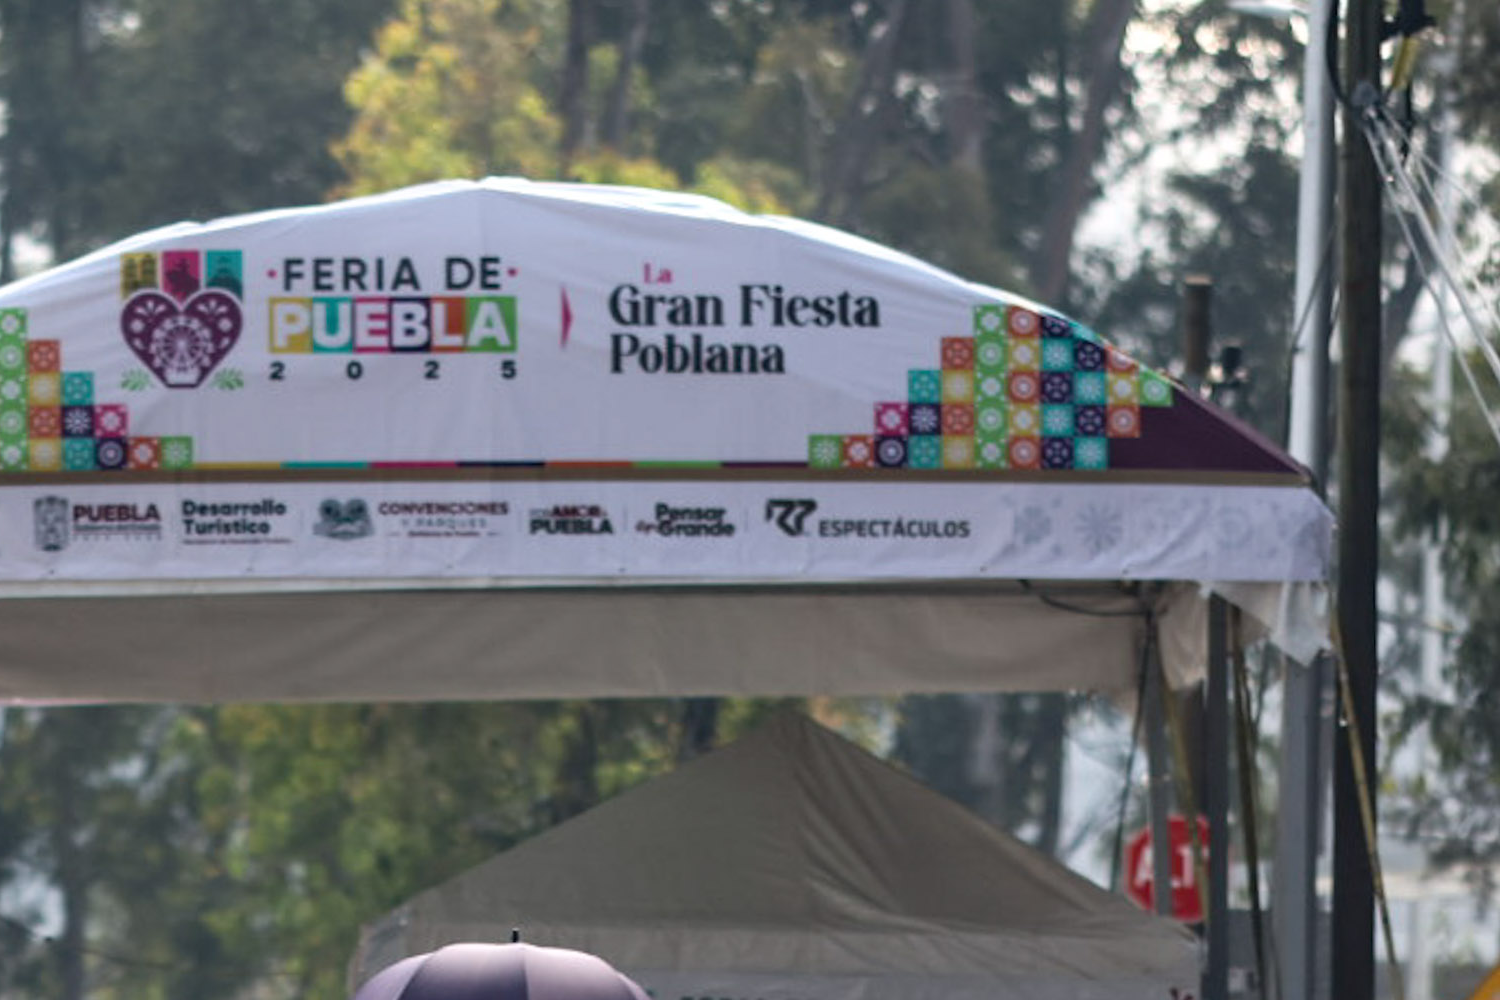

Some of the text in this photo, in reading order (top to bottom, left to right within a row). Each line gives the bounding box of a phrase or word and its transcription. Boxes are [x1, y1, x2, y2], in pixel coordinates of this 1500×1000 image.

[283, 256, 502, 292] FERIA DE
[643, 262, 674, 285] La
[608, 283, 881, 329] Gran Fiesta
[274, 299, 513, 351] PUEBLA
[610, 333, 786, 375] Poblana
[268, 360, 518, 381] 2025
[73, 503, 161, 522] PUEBLA
[182, 499, 287, 516] Desarrollo
[378, 502, 509, 516] CONVENCIONES
[655, 502, 727, 520] Pensar
[530, 518, 614, 535] PUEBLA
[658, 520, 736, 537] Grande
[818, 517, 971, 538] ESPECTÁCULOS
